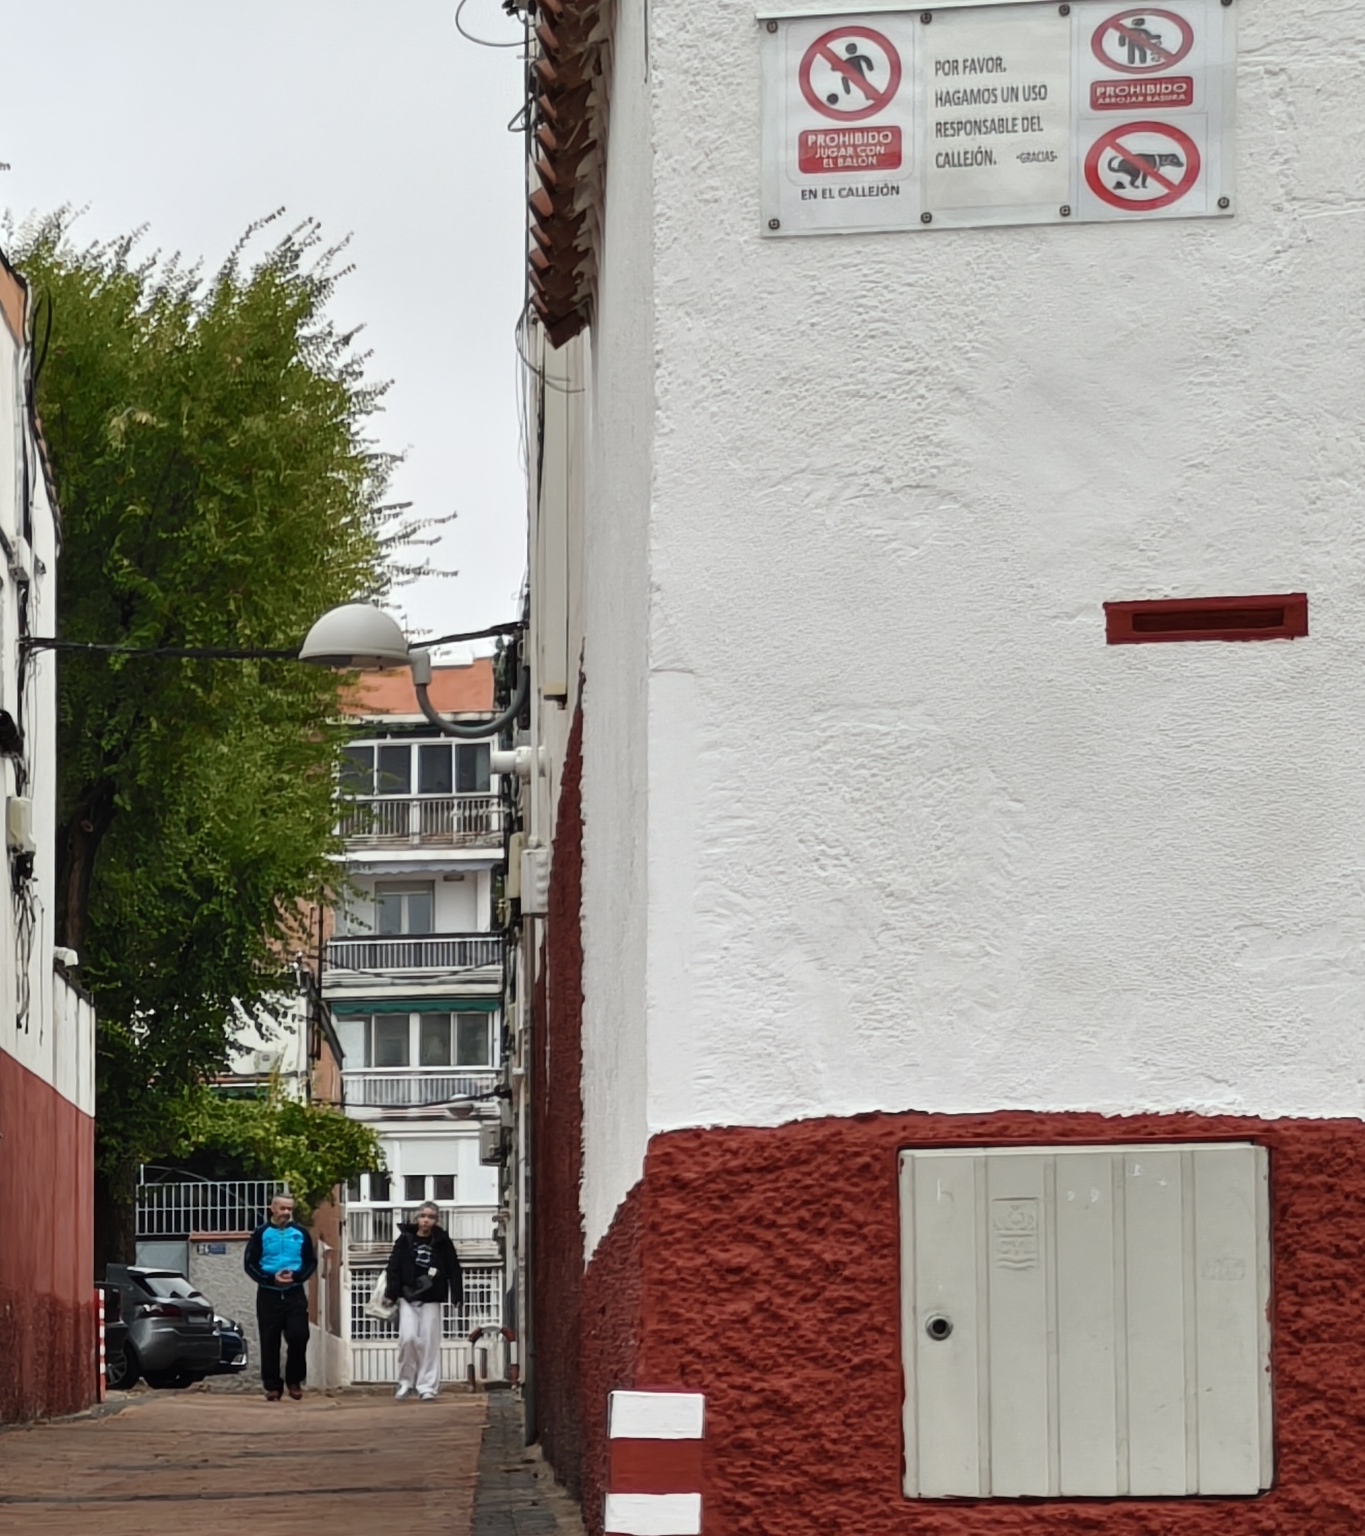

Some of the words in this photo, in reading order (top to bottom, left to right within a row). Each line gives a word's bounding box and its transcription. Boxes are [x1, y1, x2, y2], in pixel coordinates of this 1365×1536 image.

[934, 58, 960, 77] POR
[934, 87, 998, 108] HAGAMOS
[1000, 85, 1019, 103] UN
[1022, 84, 1048, 102] USO
[1096, 82, 1188, 97] PROHIBIDO
[934, 117, 1019, 138] RESPONSABLE
[1021, 115, 1044, 132] DEL
[807, 131, 893, 147] PROHIBIDO
[815, 146, 854, 158] JUGAR
[856, 145, 885, 156] CON
[935, 145, 998, 168] CALLEJÓN.
[822, 158, 835, 168] EL
[800, 187, 818, 201] EN
[821, 186, 836, 199] EL
[837, 182, 900, 198] CALLEJÓN
